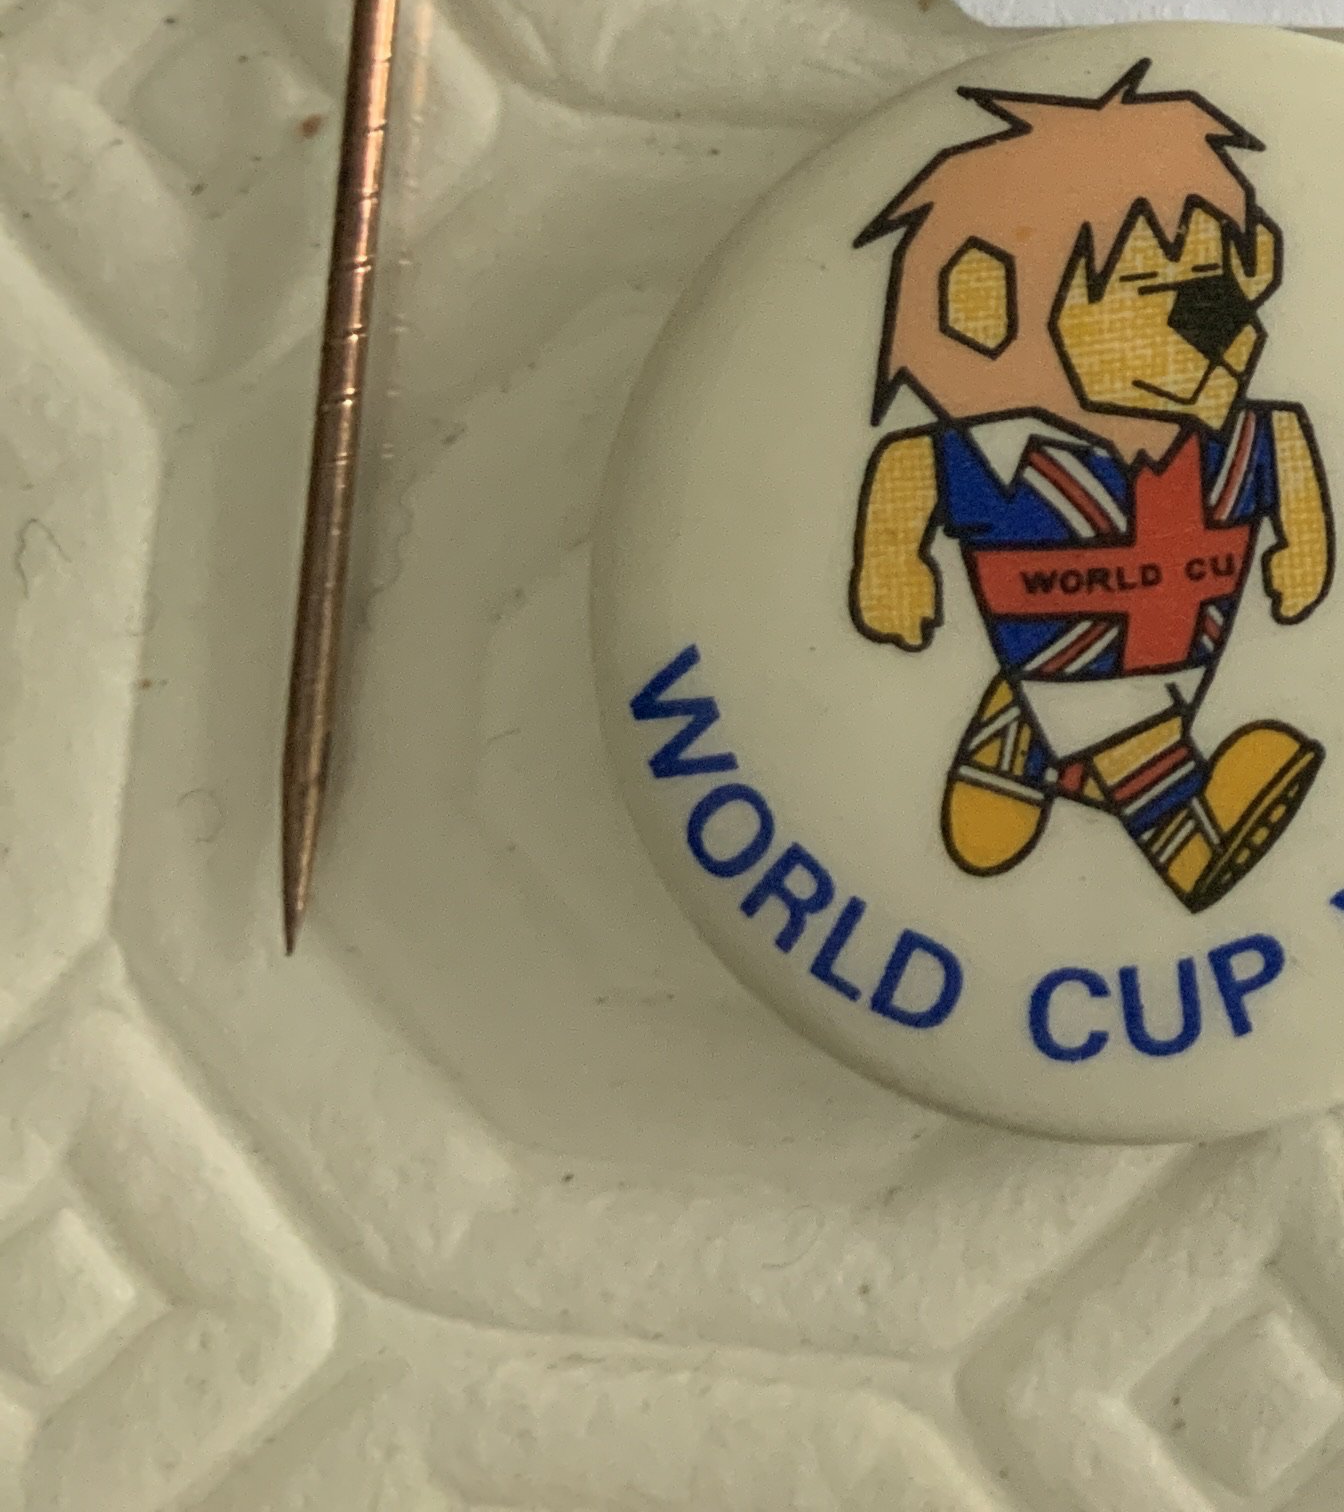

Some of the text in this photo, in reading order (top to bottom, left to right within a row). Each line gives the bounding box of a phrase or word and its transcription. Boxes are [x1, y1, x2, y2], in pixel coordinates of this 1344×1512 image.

[1020, 559, 1162, 597] WORLD
[628, 643, 964, 1030] WORLD
[1028, 931, 1286, 1063] CUP
